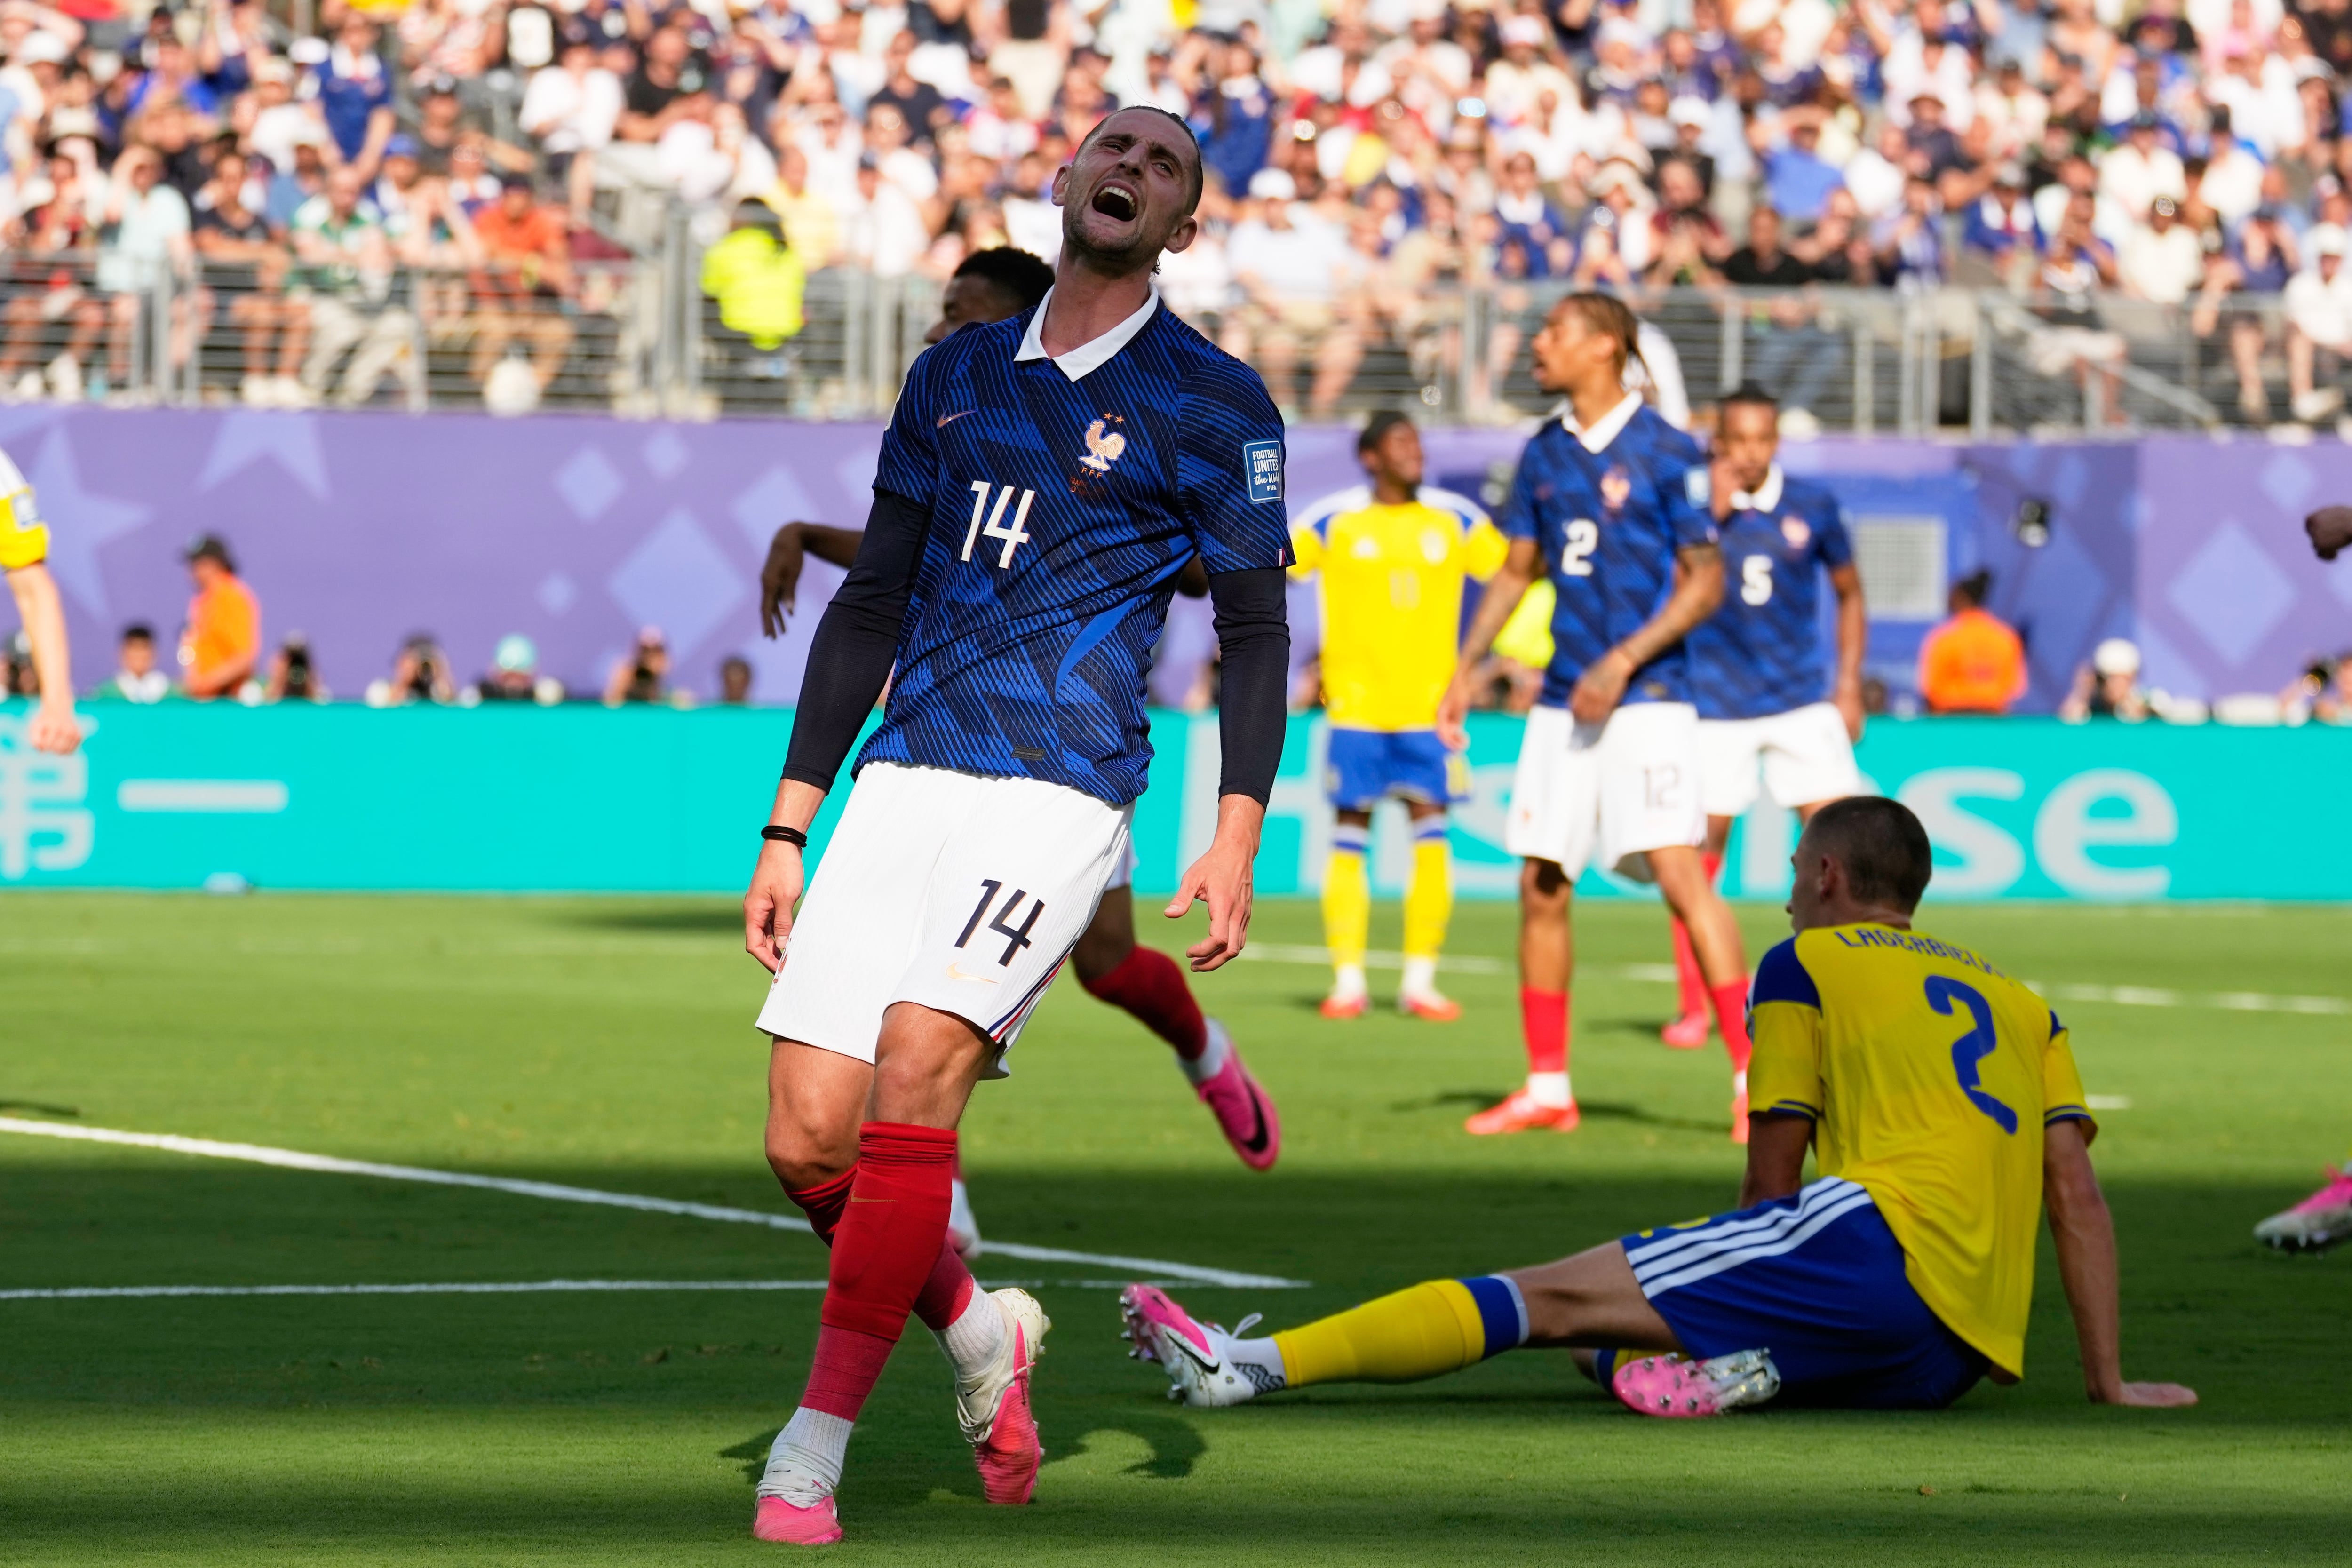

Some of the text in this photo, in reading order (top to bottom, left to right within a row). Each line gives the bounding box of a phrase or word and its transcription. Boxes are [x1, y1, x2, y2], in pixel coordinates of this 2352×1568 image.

[1252, 449, 1278, 460] FOOTBALL
[1254, 459, 1279, 473] UNITES
[1253, 473, 1268, 486] the
[961, 480, 1035, 569] 14
[1740, 555, 1773, 606] 5
[1641, 762, 1682, 810] 12
[954, 878, 1045, 968] 14
[1924, 974, 2018, 1135] 2
